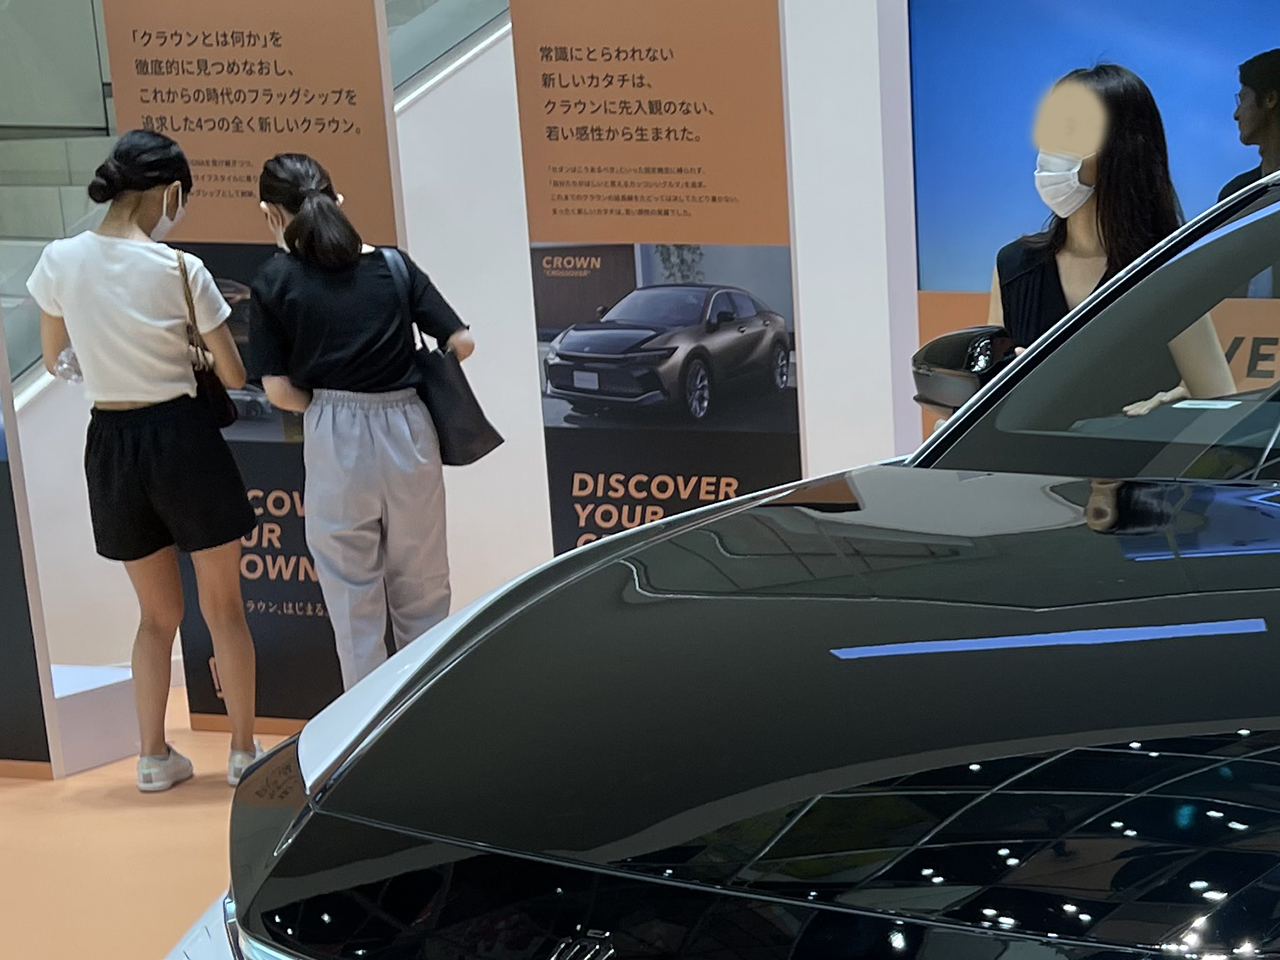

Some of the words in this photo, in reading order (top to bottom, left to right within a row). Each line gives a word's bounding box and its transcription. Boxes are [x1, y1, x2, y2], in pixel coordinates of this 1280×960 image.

[132, 29, 283, 48] 「クラウンとは何か」を
[539, 45, 674, 62] 常識にとらわれない
[135, 59, 294, 77] 徹底的に見つめなおし、
[541, 73, 653, 89] 新しいカタチは、
[139, 88, 358, 107] これからの時代のフラッグシップを
[543, 99, 715, 116] クラウンに先入観のない、
[141, 115, 362, 136] 追求した4つの全く新しいクラウン。
[545, 125, 702, 142] 若い感性から生まれた。
[542, 255, 601, 269] CROWN
[571, 472, 739, 501] DISCOVER
